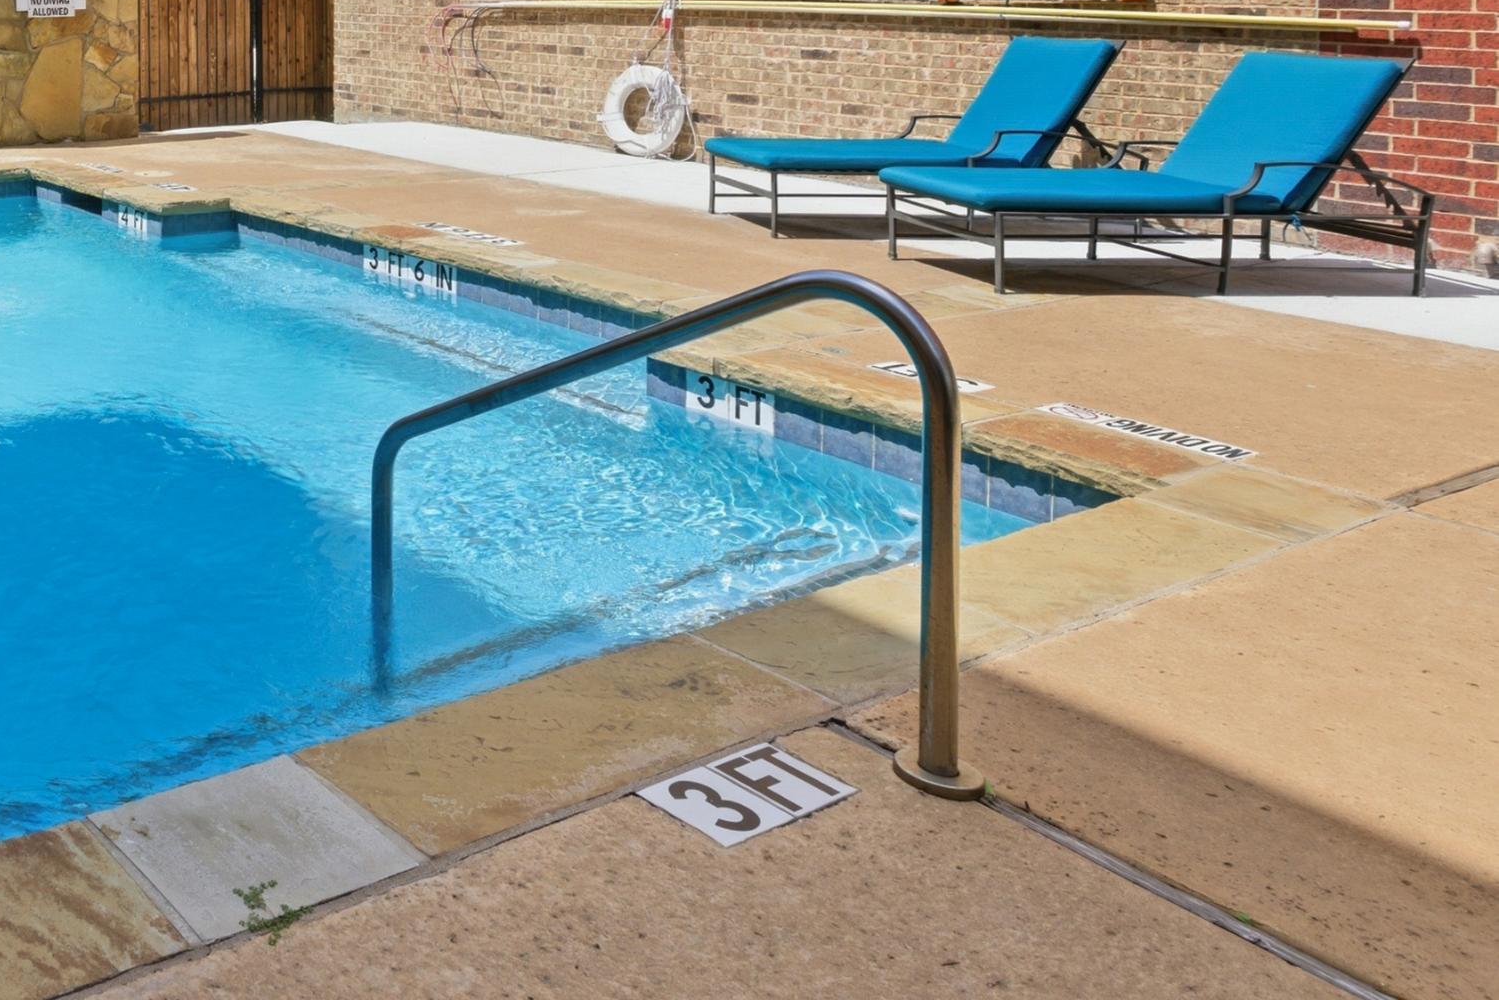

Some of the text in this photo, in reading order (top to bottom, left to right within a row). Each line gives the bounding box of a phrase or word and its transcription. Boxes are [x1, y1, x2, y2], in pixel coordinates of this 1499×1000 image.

[32, 8, 69, 16] ALLOWED
[121, 206, 128, 226] 4
[369, 247, 453, 291] 3 FT 6 IN
[697, 375, 766, 426] 3 FT
[1107, 419, 1251, 458] NO DIVING
[668, 746, 841, 831] 3 FT
